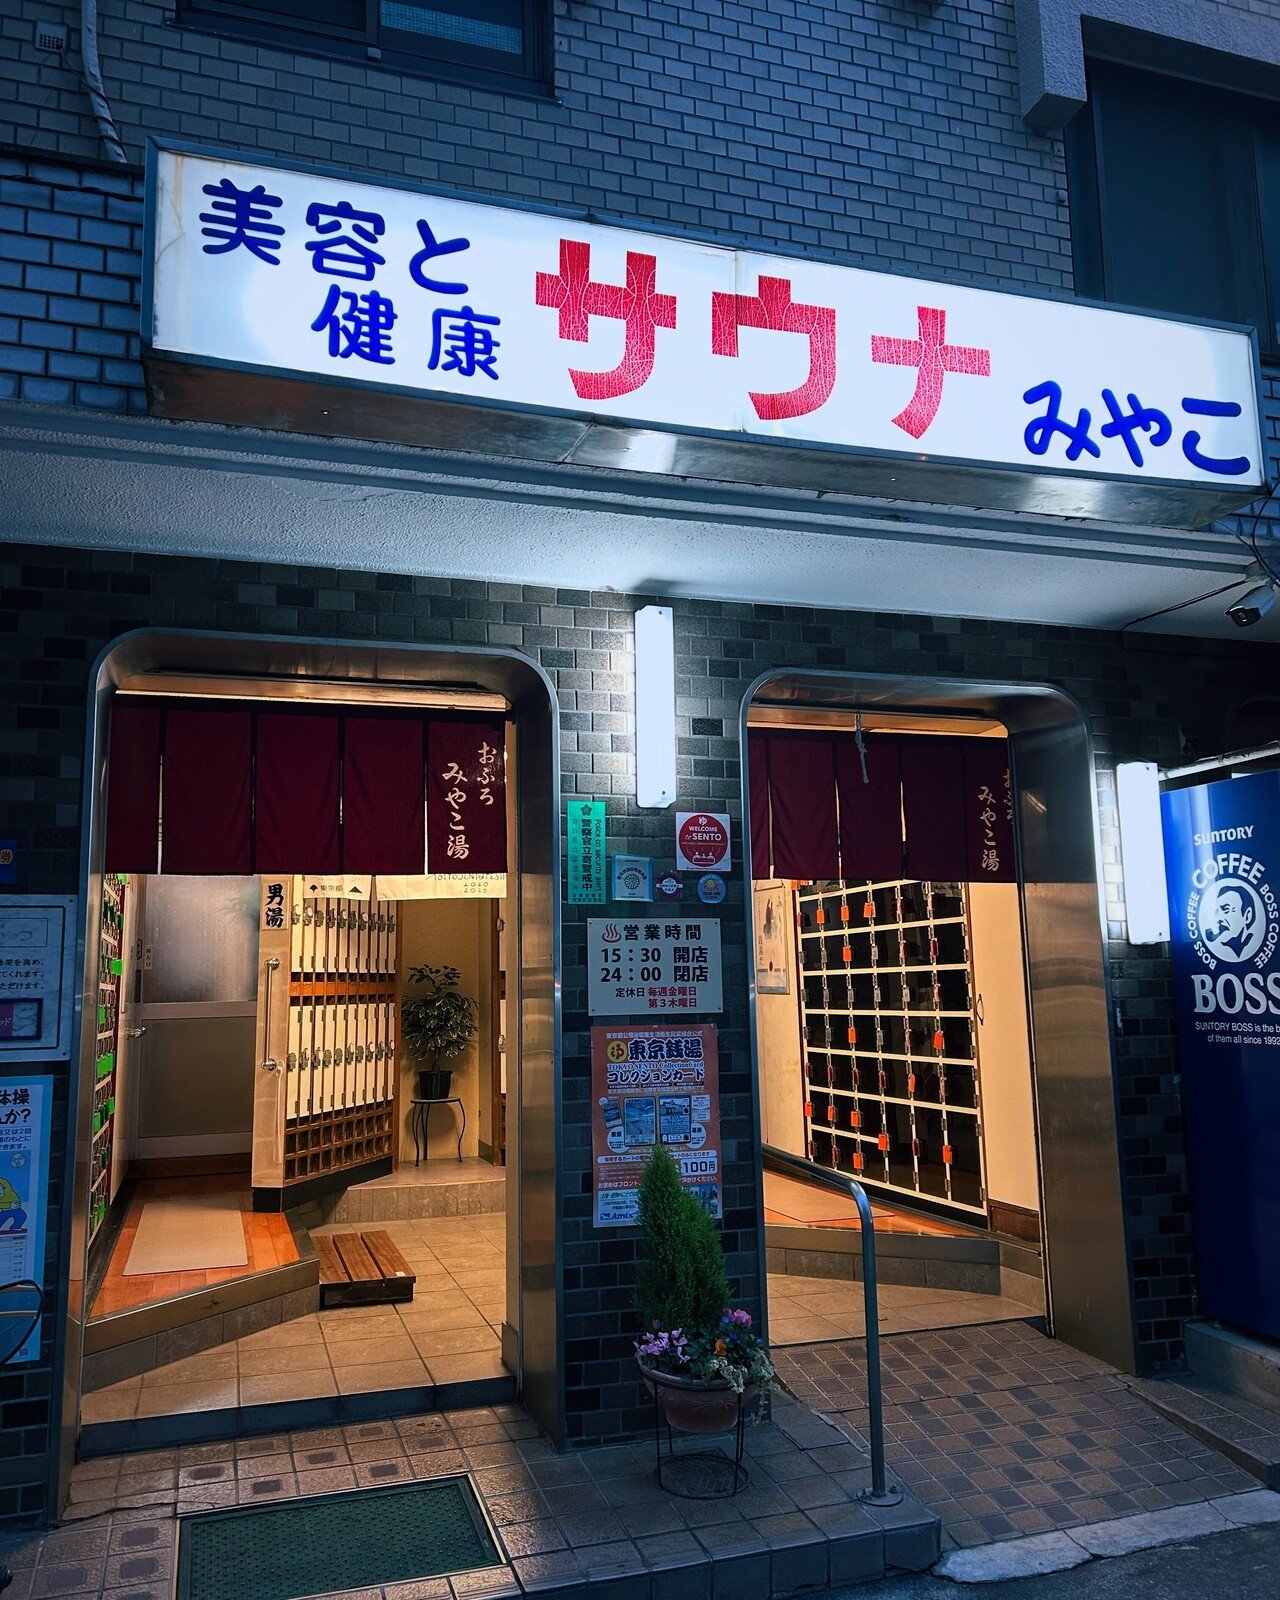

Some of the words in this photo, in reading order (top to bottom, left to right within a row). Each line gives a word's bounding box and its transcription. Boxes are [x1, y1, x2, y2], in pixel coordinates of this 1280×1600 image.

[199, 178, 471, 295] 美容と
[311, 284, 502, 380] 健康
[535, 239, 991, 440] サウナ
[1023, 380, 1251, 475] みやこ
[477, 741, 498, 806] おふろ
[442, 763, 470, 860] みやこ湯
[977, 785, 1000, 872] みやこ湯
[692, 832, 722, 841] SENTO
[1194, 825, 1255, 846] SUNTORY
[581, 818, 593, 892] 警察官立寄警戒中
[1192, 852, 1266, 889] COFFEE
[265, 882, 285, 929] 男湯
[1187, 891, 1201, 940] COFFEE
[1259, 883, 1280, 920] BOSS
[623, 924, 702, 941] 営業時間
[1253, 922, 1280, 970] COFFEE
[673, 946, 709, 964] 開店
[1193, 940, 1218, 971] BOSS
[673, 965, 709, 983] 閉店
[615, 987, 645, 998] 定休日
[647, 986, 698, 997] 毎週金曜日
[648, 998, 698, 1008] 第3木曜日
[1191, 972, 1280, 1015] BOSS
[1195, 1021, 1230, 1031] SUNTORY
[1231, 1022, 1253, 1032] BOSS
[1254, 1023, 1262, 1033] is
[1262, 1023, 1275, 1033] the
[1207, 1033, 1214, 1043] of
[1215, 1033, 1232, 1043] them
[1233, 1034, 1242, 1044] all
[1243, 1035, 1262, 1045] since
[607, 1063, 634, 1072] TOKYO
[633, 1062, 658, 1071] SENTO
[628, 1038, 705, 1062] 東京銭湯
[607, 1068, 705, 1084] コレクションカード
[683, 1160, 716, 1174] 100円
